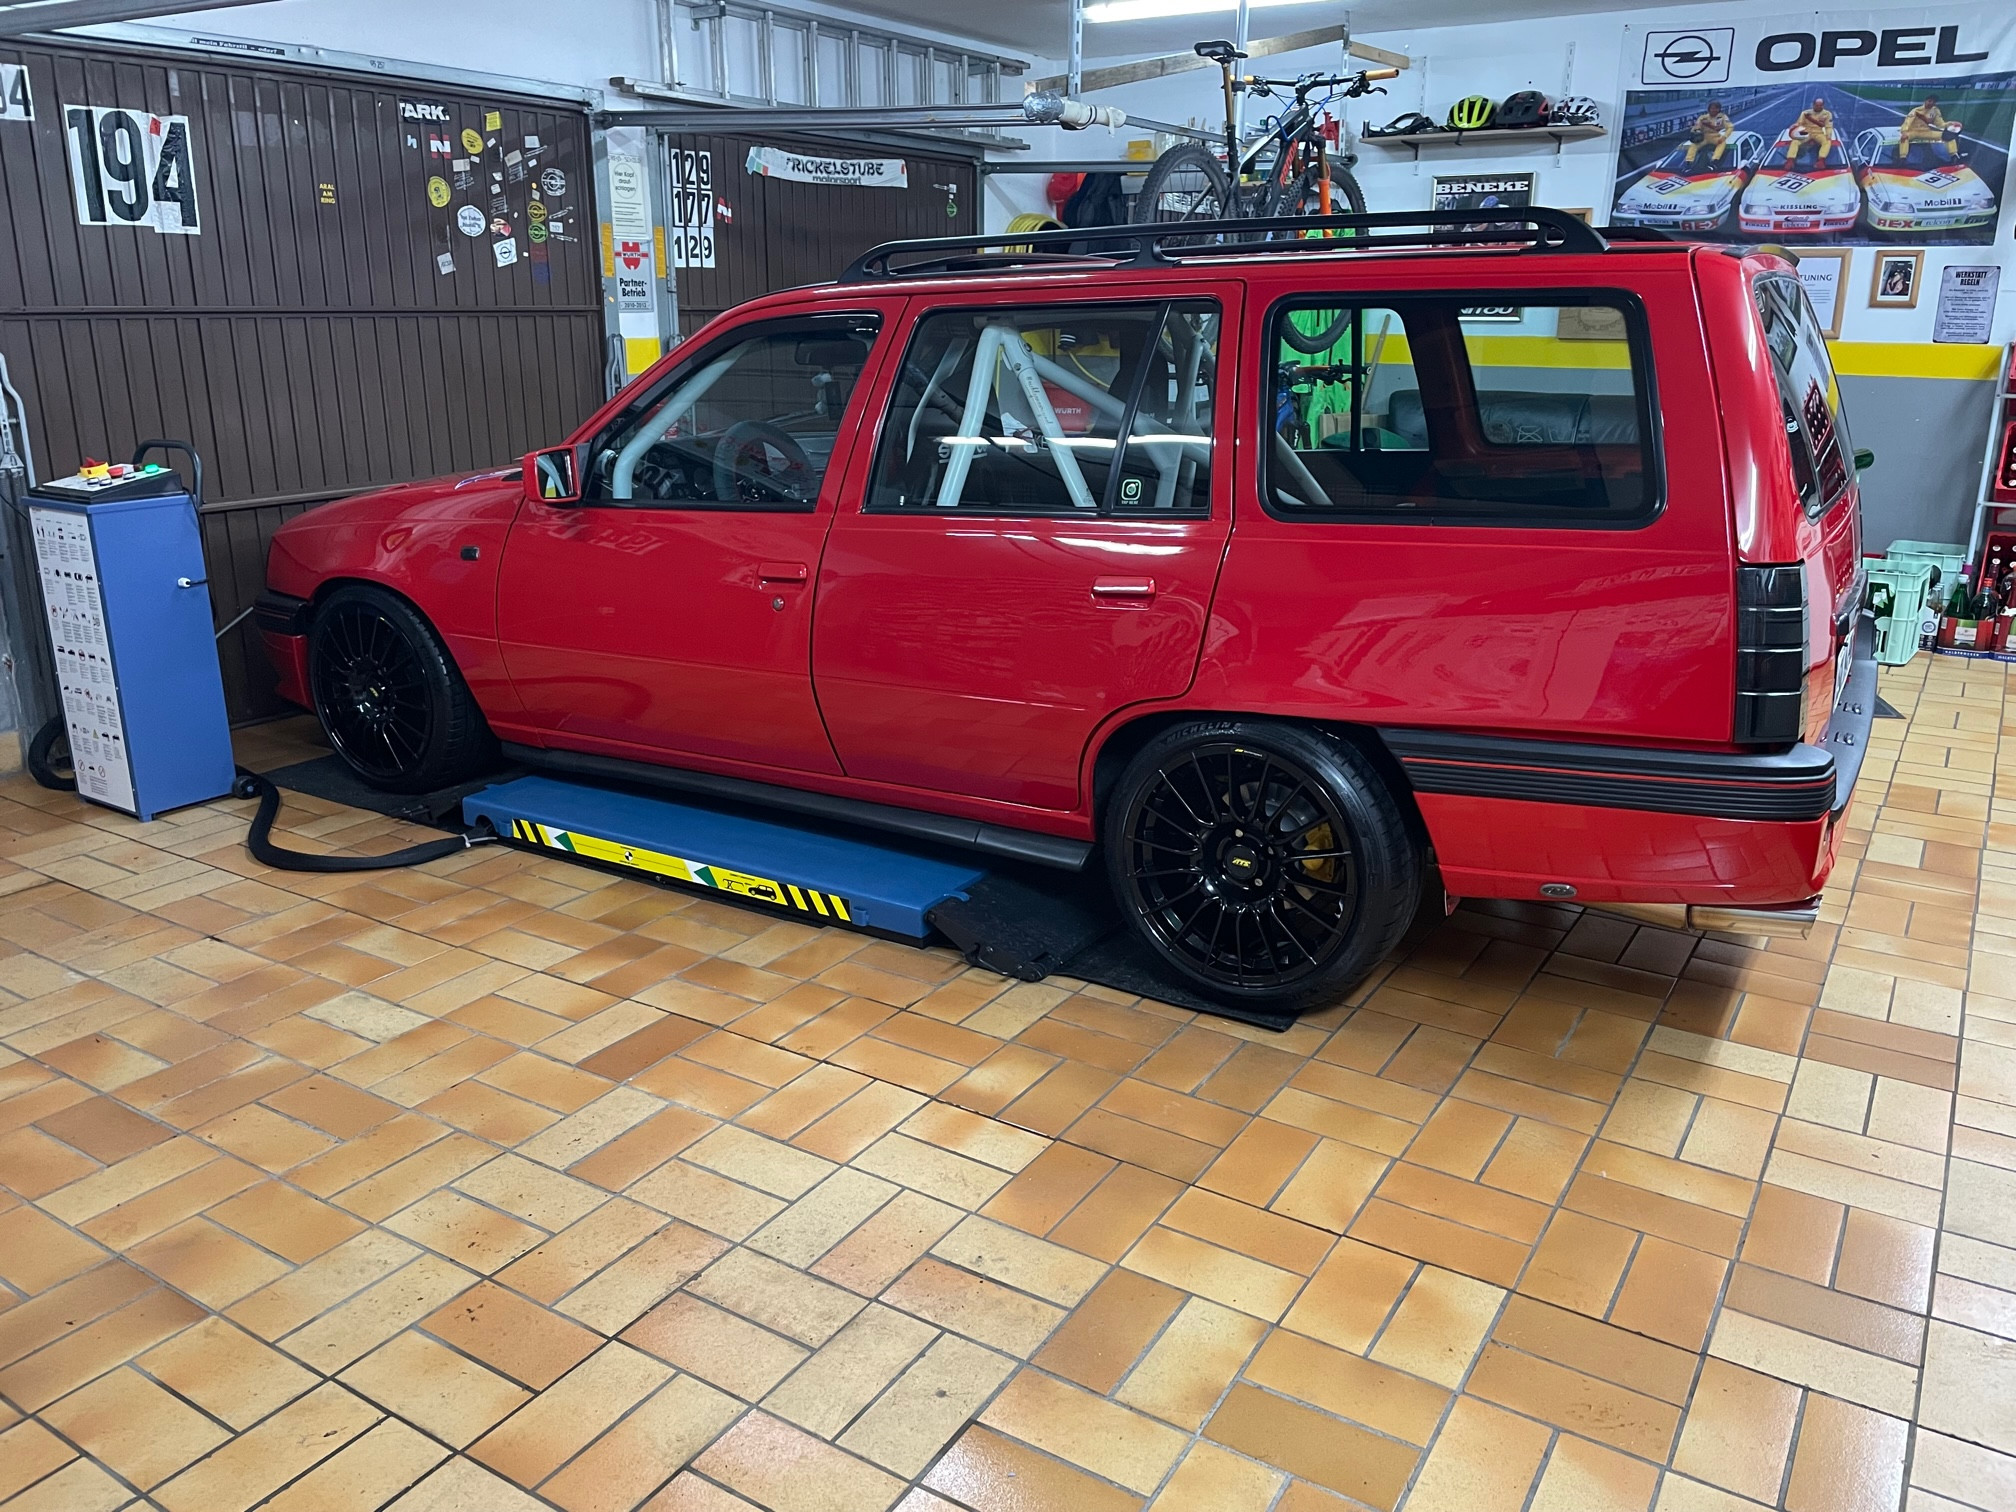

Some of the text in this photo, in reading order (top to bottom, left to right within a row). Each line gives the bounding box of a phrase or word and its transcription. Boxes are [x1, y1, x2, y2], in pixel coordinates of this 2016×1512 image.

[1755, 25, 1989, 71] OPEL
[67, 108, 198, 227] 194
[673, 152, 709, 185] 129
[1279, 138, 1298, 189] RADON
[1436, 181, 1529, 194] BENEKE
[1777, 179, 1803, 190] 40
[675, 191, 711, 225] 177
[1924, 198, 1952, 207] Mobil
[1681, 219, 1719, 231] REX
[1877, 219, 1914, 229] REX
[675, 235, 712, 259] 129
[1955, 271, 1987, 279] WERKSTATT
[619, 278, 647, 287] Partner-
[622, 288, 646, 297] Betrieb
